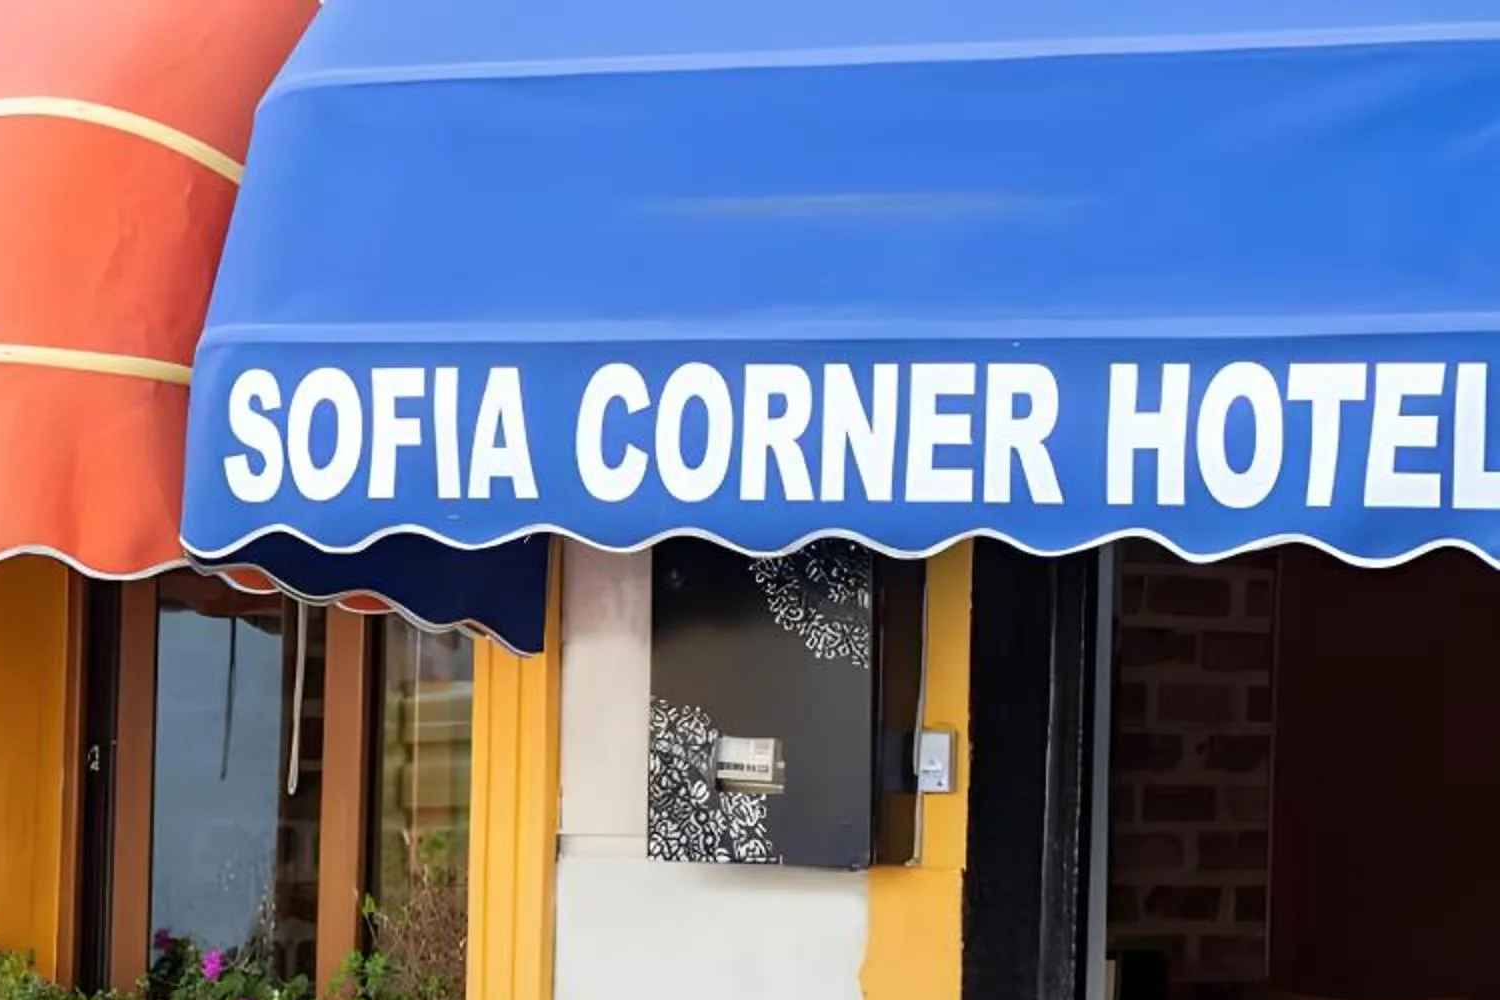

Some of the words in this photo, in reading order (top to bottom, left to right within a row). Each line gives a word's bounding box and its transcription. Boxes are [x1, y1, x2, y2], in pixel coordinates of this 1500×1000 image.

[224, 367, 539, 503] SOFIA
[576, 362, 1063, 504] CORNER
[1107, 361, 1500, 509] HOTEL
